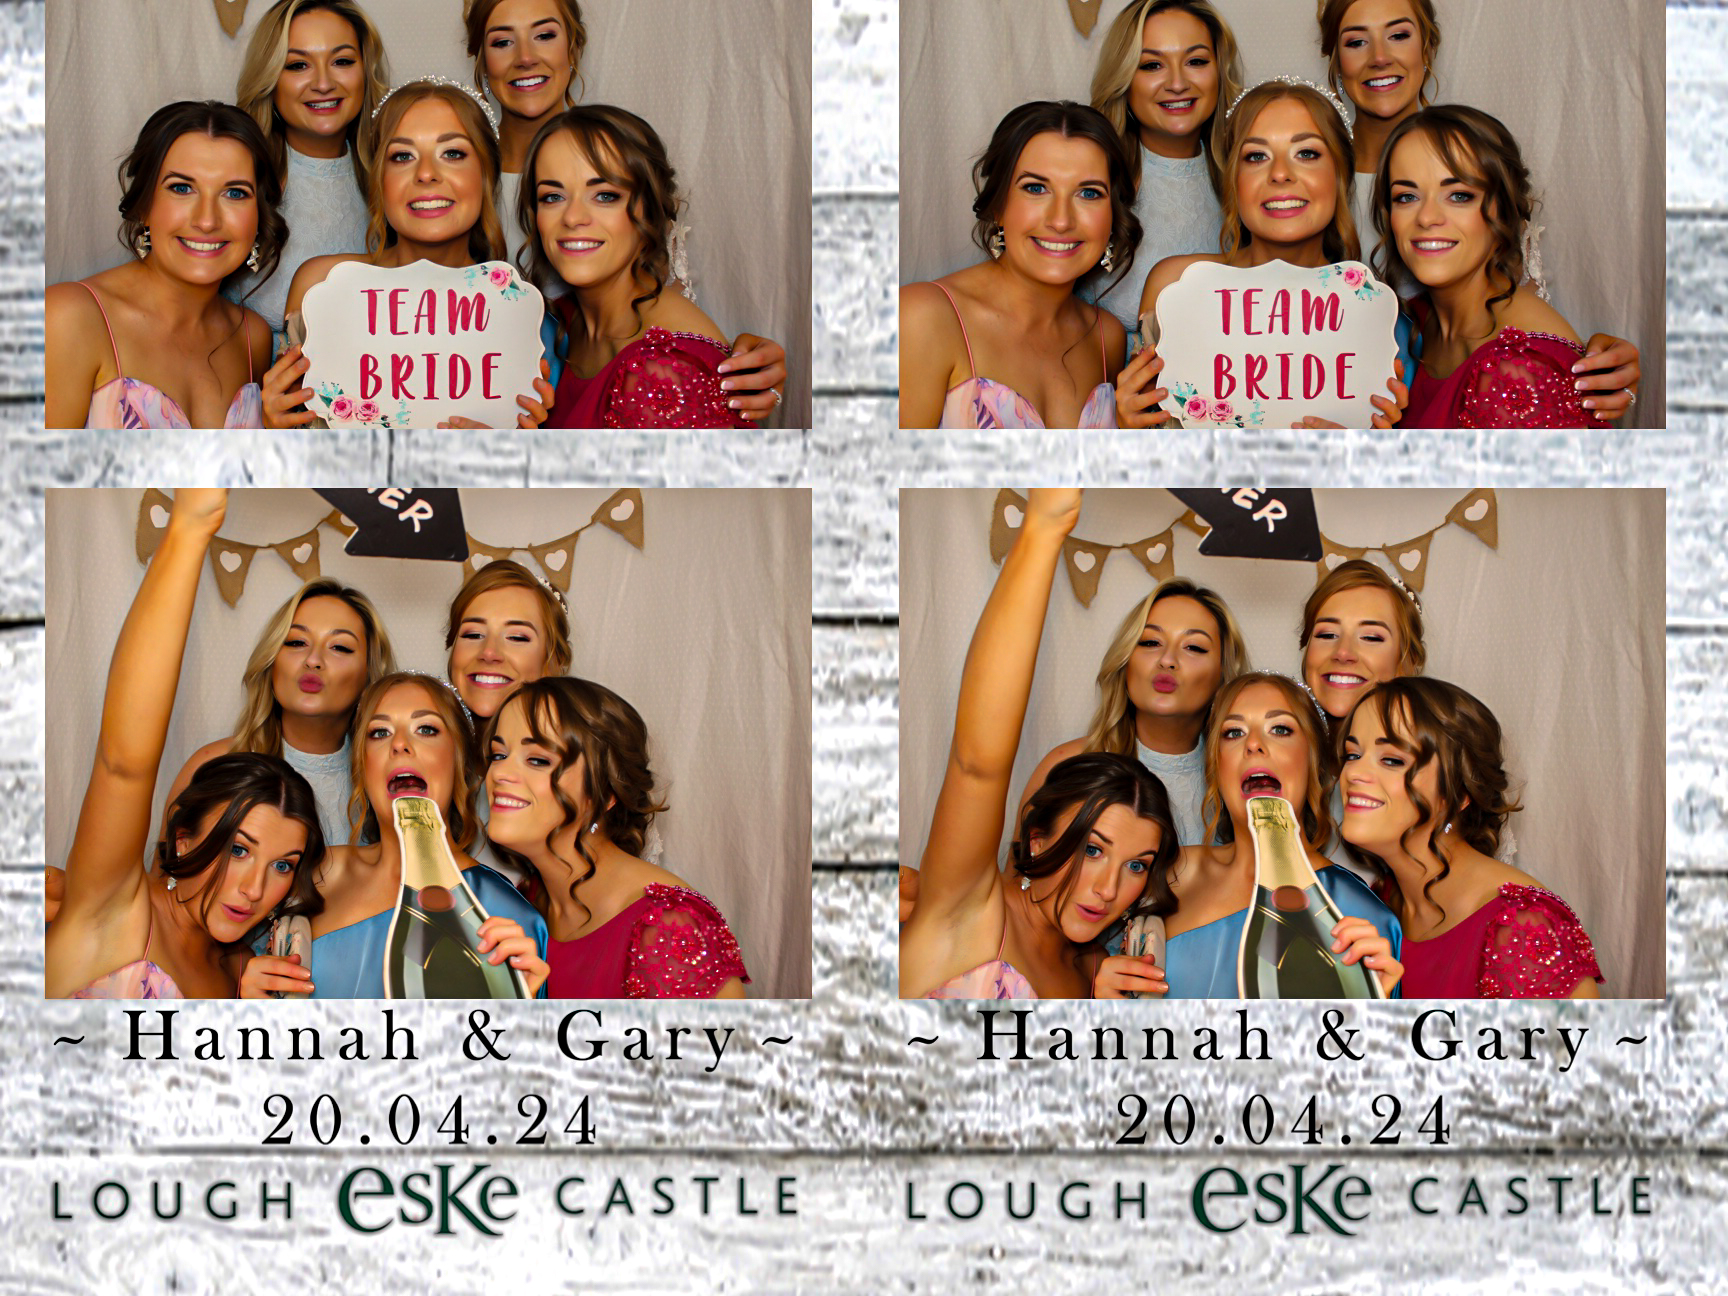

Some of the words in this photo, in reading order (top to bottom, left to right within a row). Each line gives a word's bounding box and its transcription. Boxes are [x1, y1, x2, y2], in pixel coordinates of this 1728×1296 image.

[360, 288, 491, 336] TEAM
[1214, 288, 1345, 336] TEAM
[359, 352, 502, 401] BRIDE
[1213, 352, 1356, 401] BRIDE
